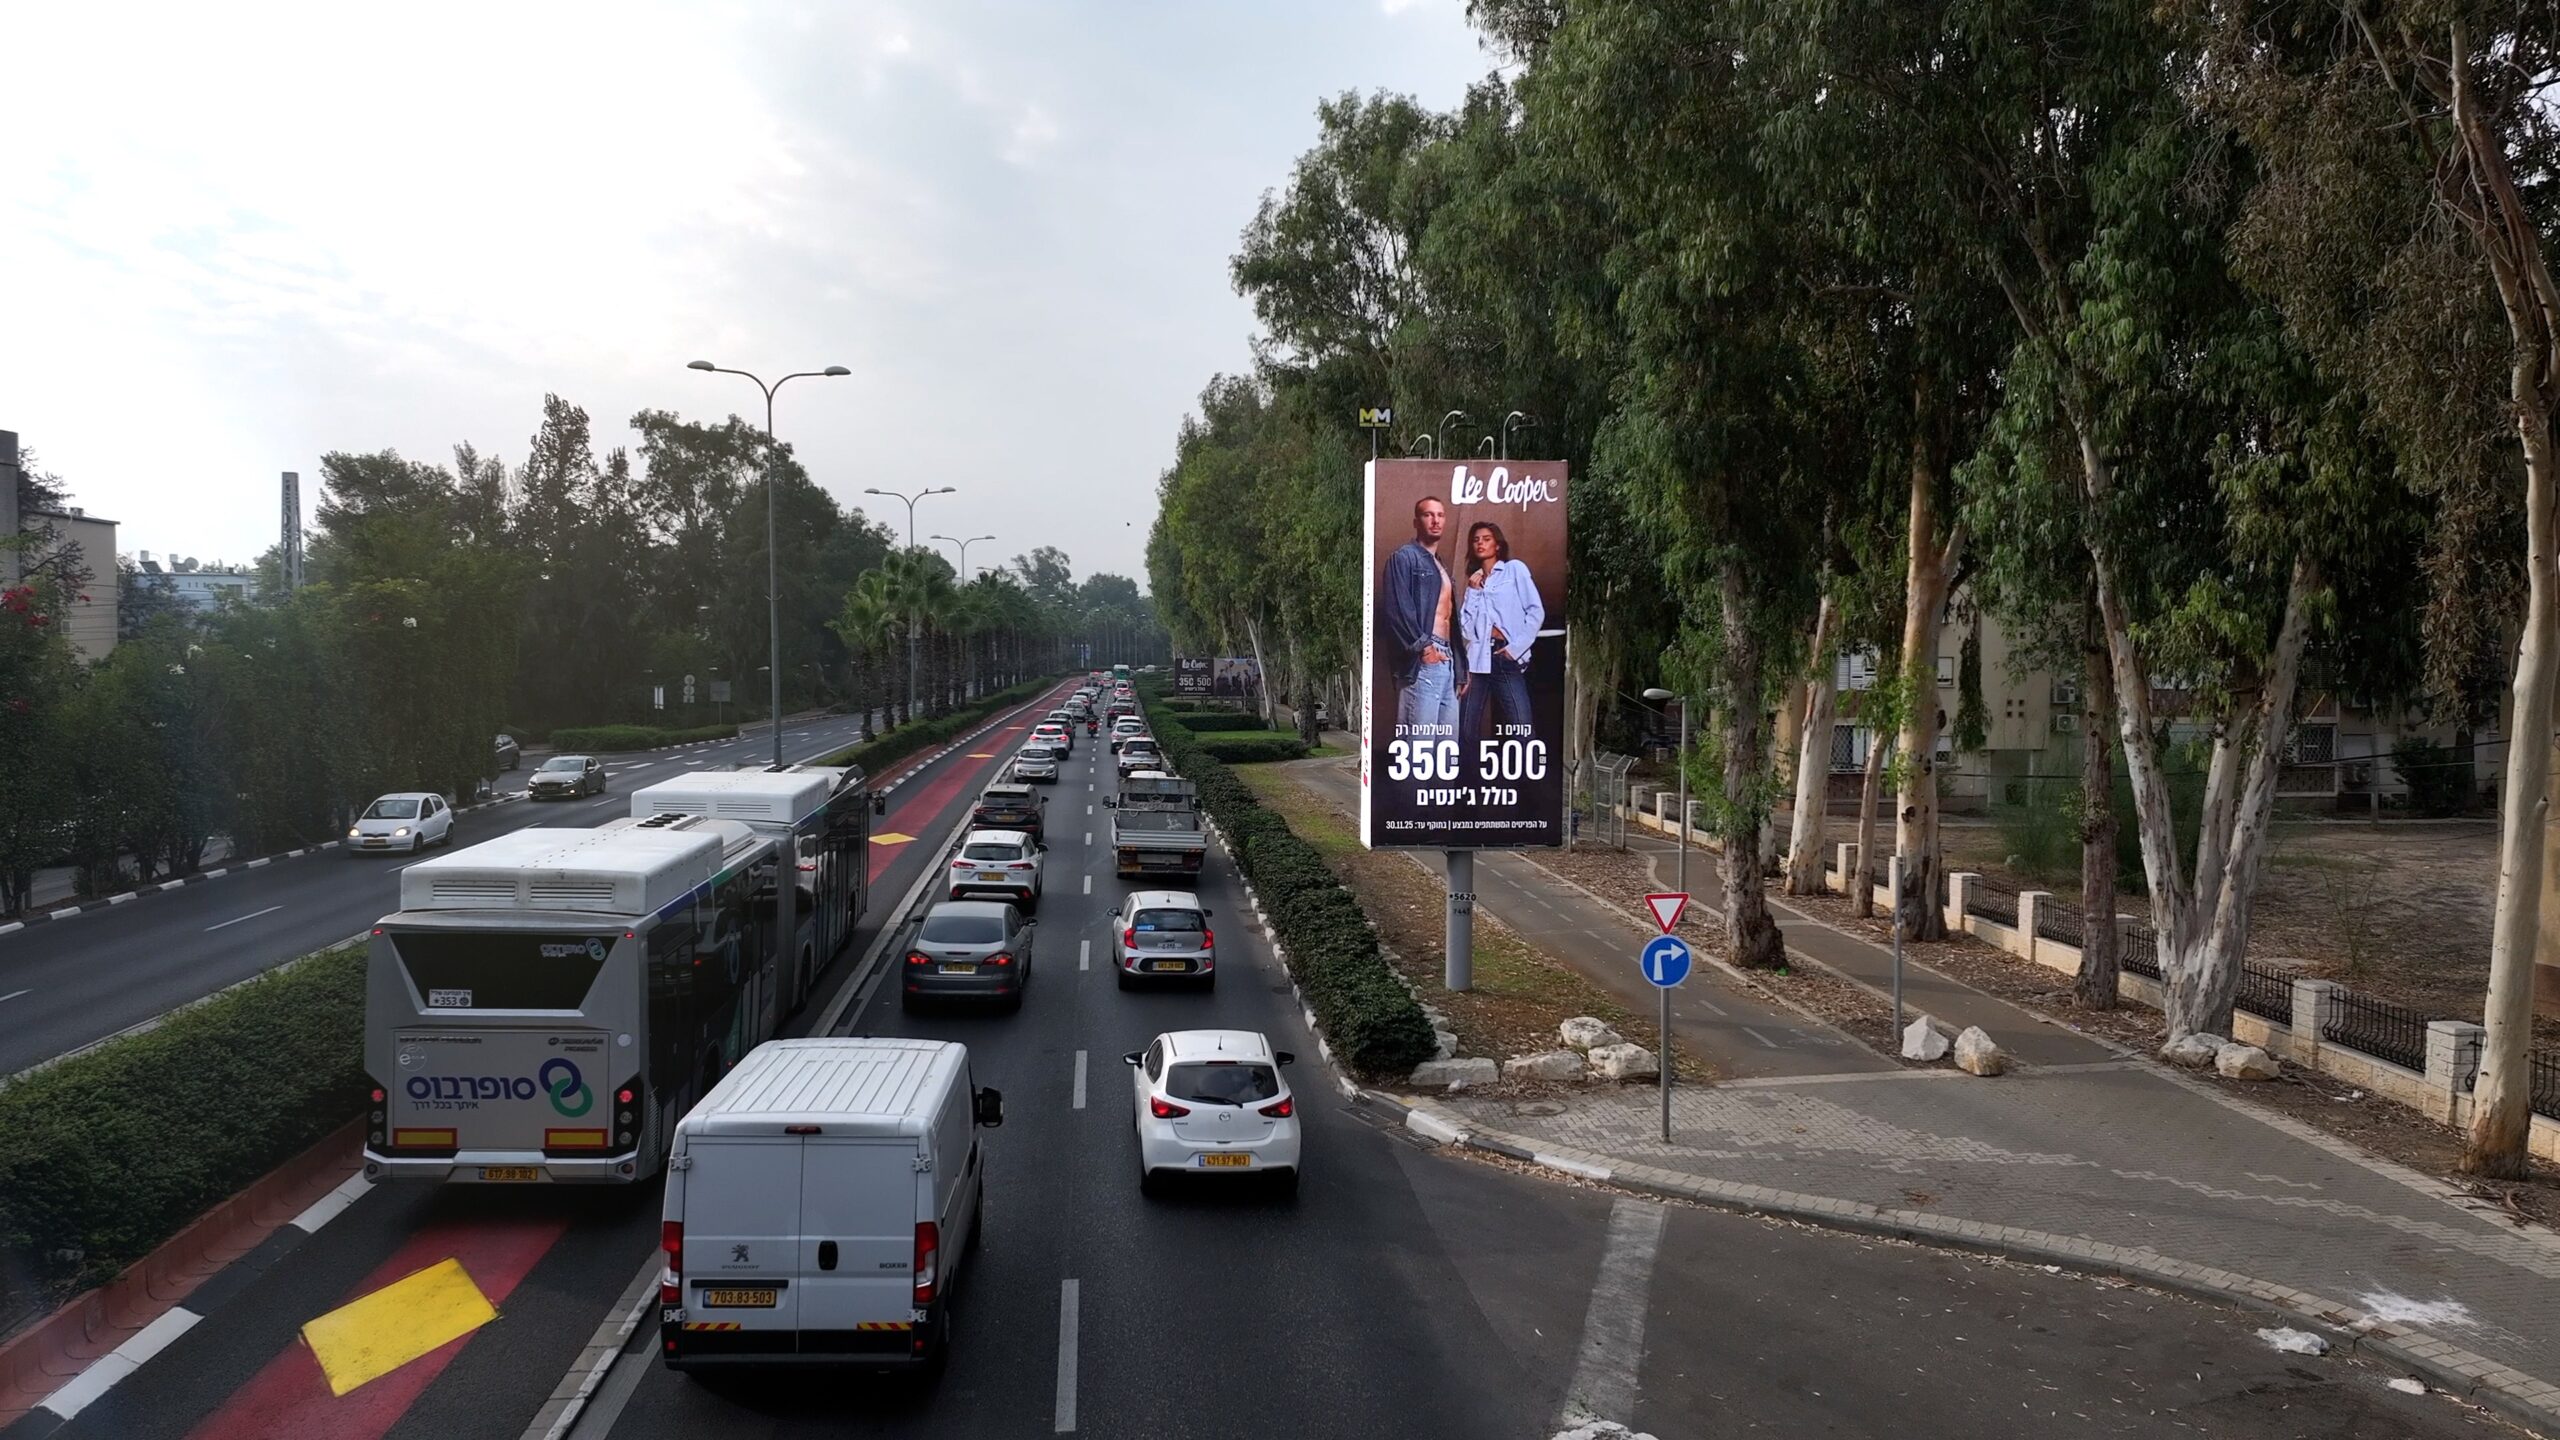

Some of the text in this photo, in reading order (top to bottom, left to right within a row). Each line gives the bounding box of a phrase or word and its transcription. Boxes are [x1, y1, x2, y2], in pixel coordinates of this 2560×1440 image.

[1359, 408, 1391, 423] MM
[1451, 465, 1558, 512] Lee Cooper
[1395, 722, 1453, 737] משלמים רק
[1495, 723, 1532, 737] קונים ב
[1481, 786, 1518, 806] כולל
[1385, 820, 1414, 829] 30.11.25
[1426, 820, 1447, 831] בתוקף
[1452, 820, 1474, 829] במבצע
[1474, 820, 1510, 829] המשתתפים
[1511, 820, 1538, 829] הפריטים
[1538, 820, 1548, 829] על
[406, 1076, 537, 1101] סופרבוס
[411, 1099, 479, 1111] איתך בכל דרך
